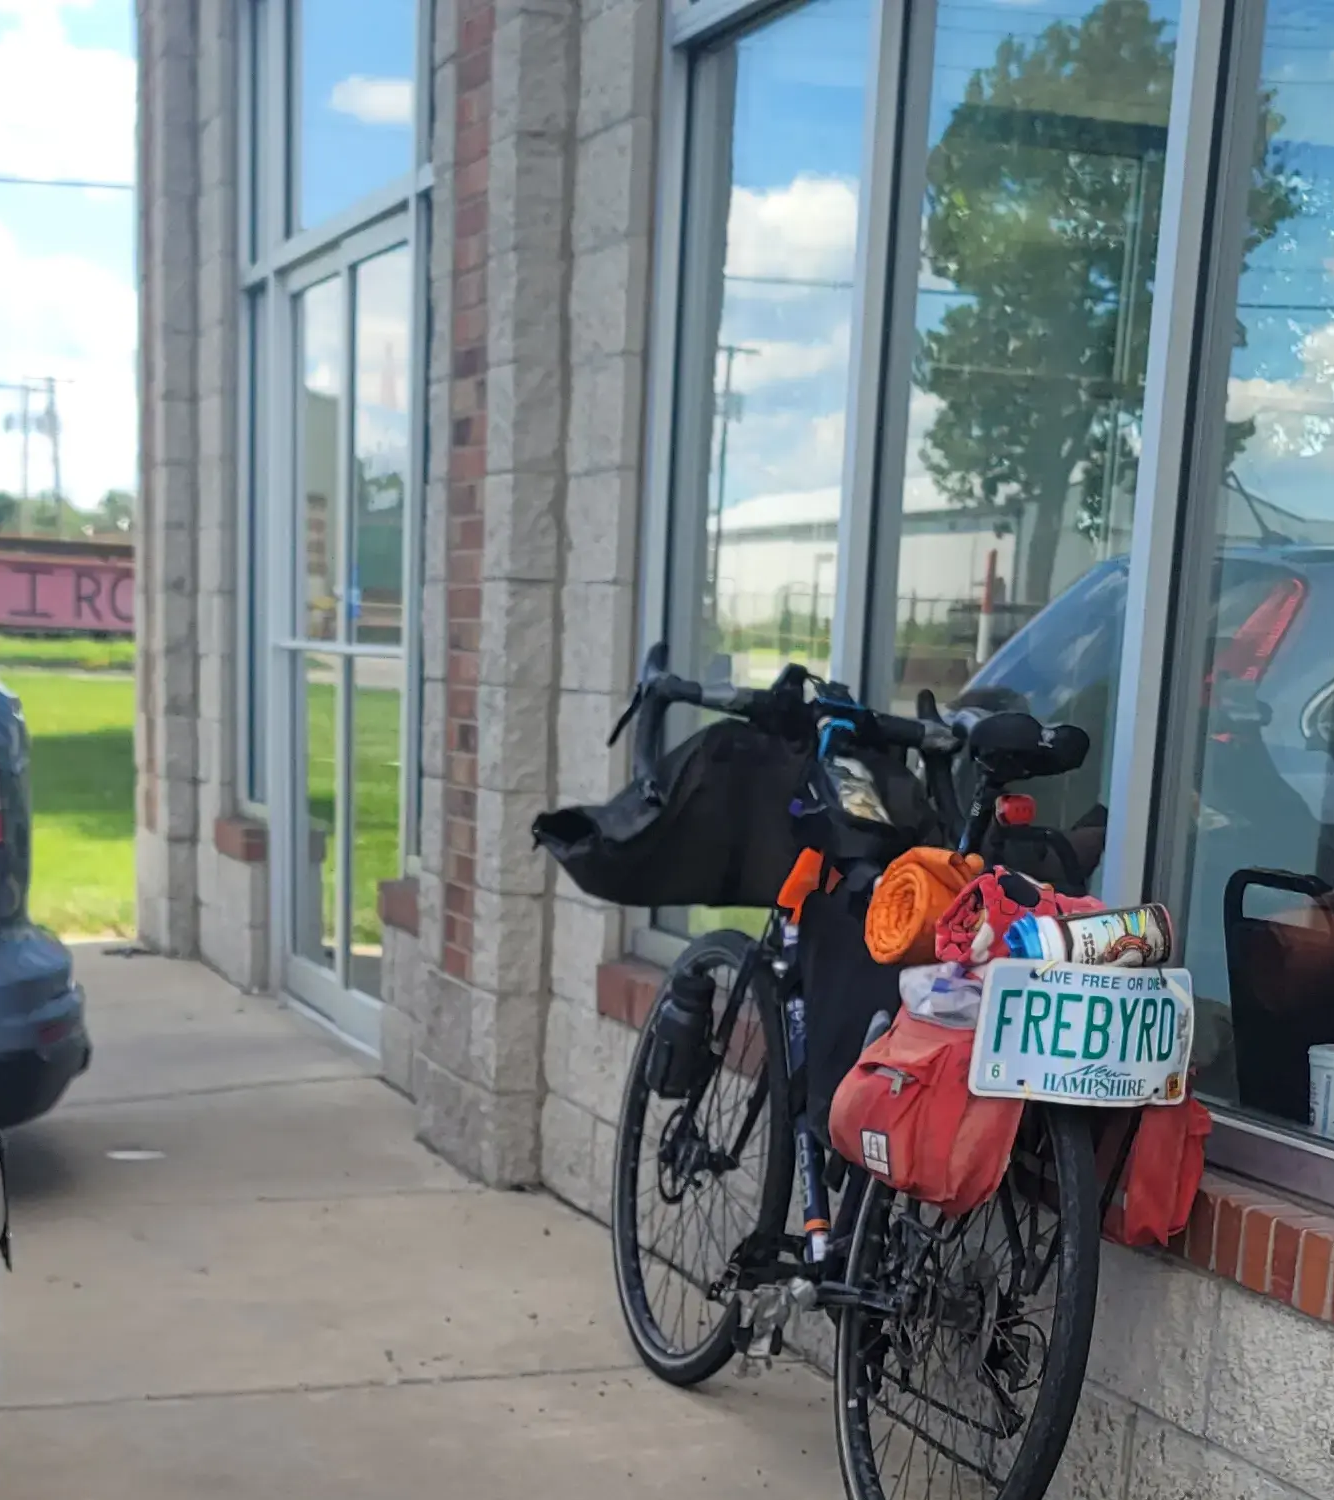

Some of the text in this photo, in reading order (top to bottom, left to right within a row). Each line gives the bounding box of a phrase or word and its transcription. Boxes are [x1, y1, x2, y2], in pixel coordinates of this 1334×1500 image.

[1041, 971, 1161, 991] LIVE FREE OR DIE
[992, 989, 1176, 1063] FREBYRD
[991, 1066, 1001, 1080] 6
[1064, 1062, 1131, 1078] New
[1043, 1072, 1146, 1097] HAMPSHIRE
